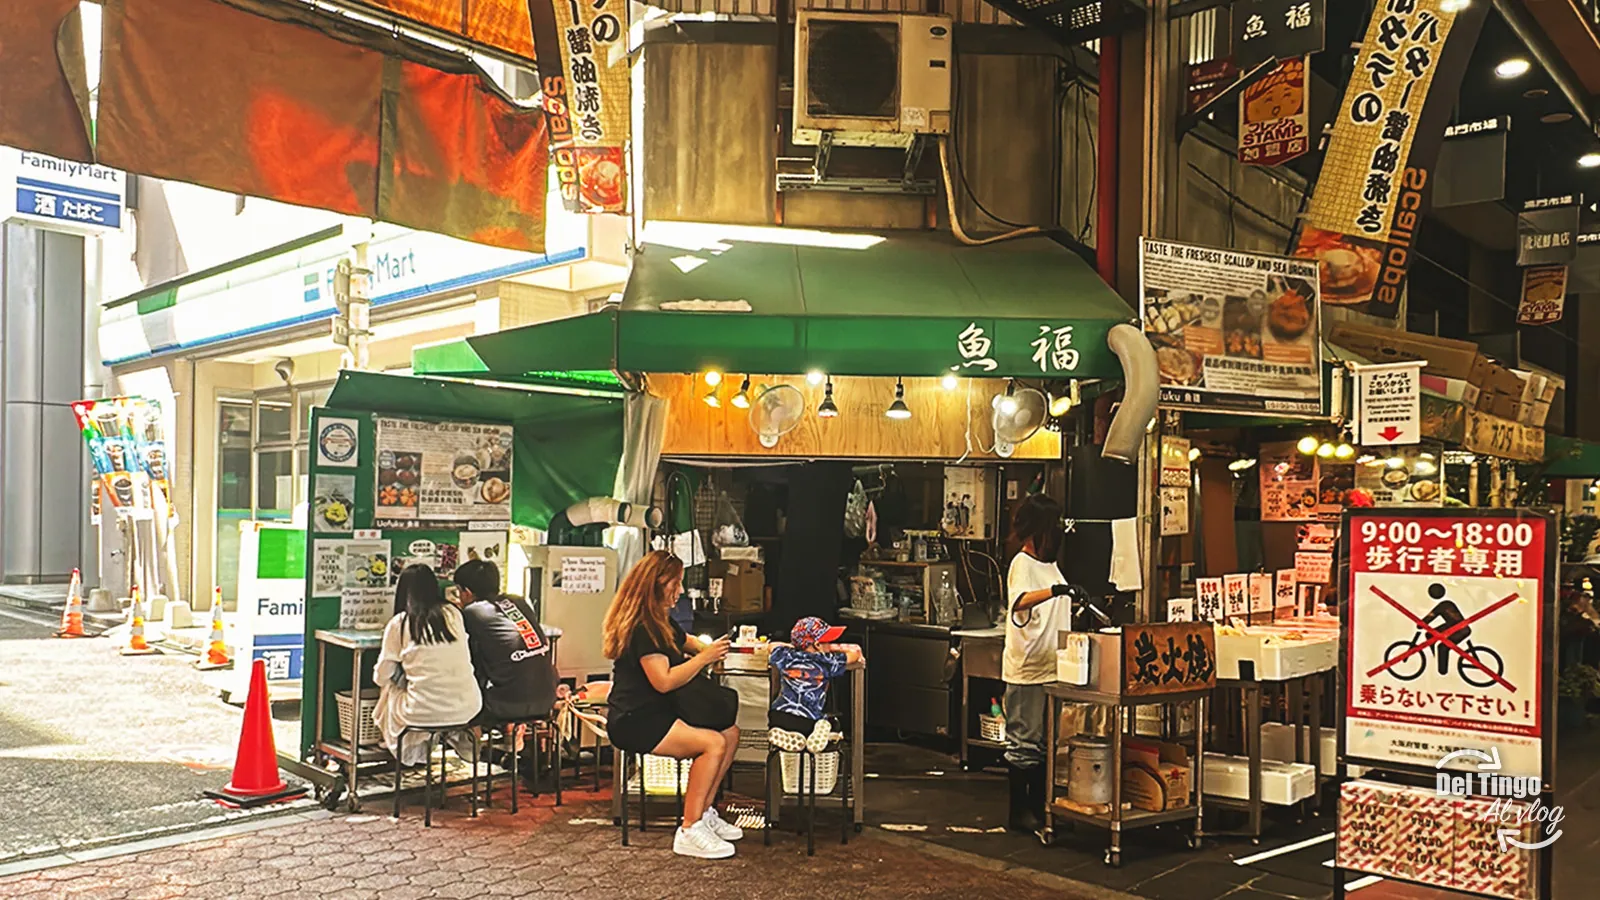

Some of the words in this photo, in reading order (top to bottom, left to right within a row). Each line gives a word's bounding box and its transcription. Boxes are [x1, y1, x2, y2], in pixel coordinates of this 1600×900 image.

[1242, 2, 1312, 40] 魚福
[544, 76, 577, 201] Scallops
[1243, 125, 1303, 145] STAMP
[21, 151, 117, 182] FamilyMart
[34, 193, 57, 216] 酒
[62, 200, 104, 222] たばこ
[1378, 167, 1427, 304] Scallops
[1145, 242, 1168, 256] TASTE
[1170, 246, 1184, 259] THE
[1186, 248, 1222, 264] FRESHEST
[1224, 254, 1255, 269] SCALLOP
[1257, 260, 1271, 271] AND
[1273, 262, 1287, 273] SEA
[1289, 264, 1315, 277] URCHIN
[950, 322, 1080, 372] 魚福
[1369, 387, 1411, 396] お願いします
[1372, 372, 1408, 381] オーダーは
[1365, 546, 1523, 576] 歩行者専用
